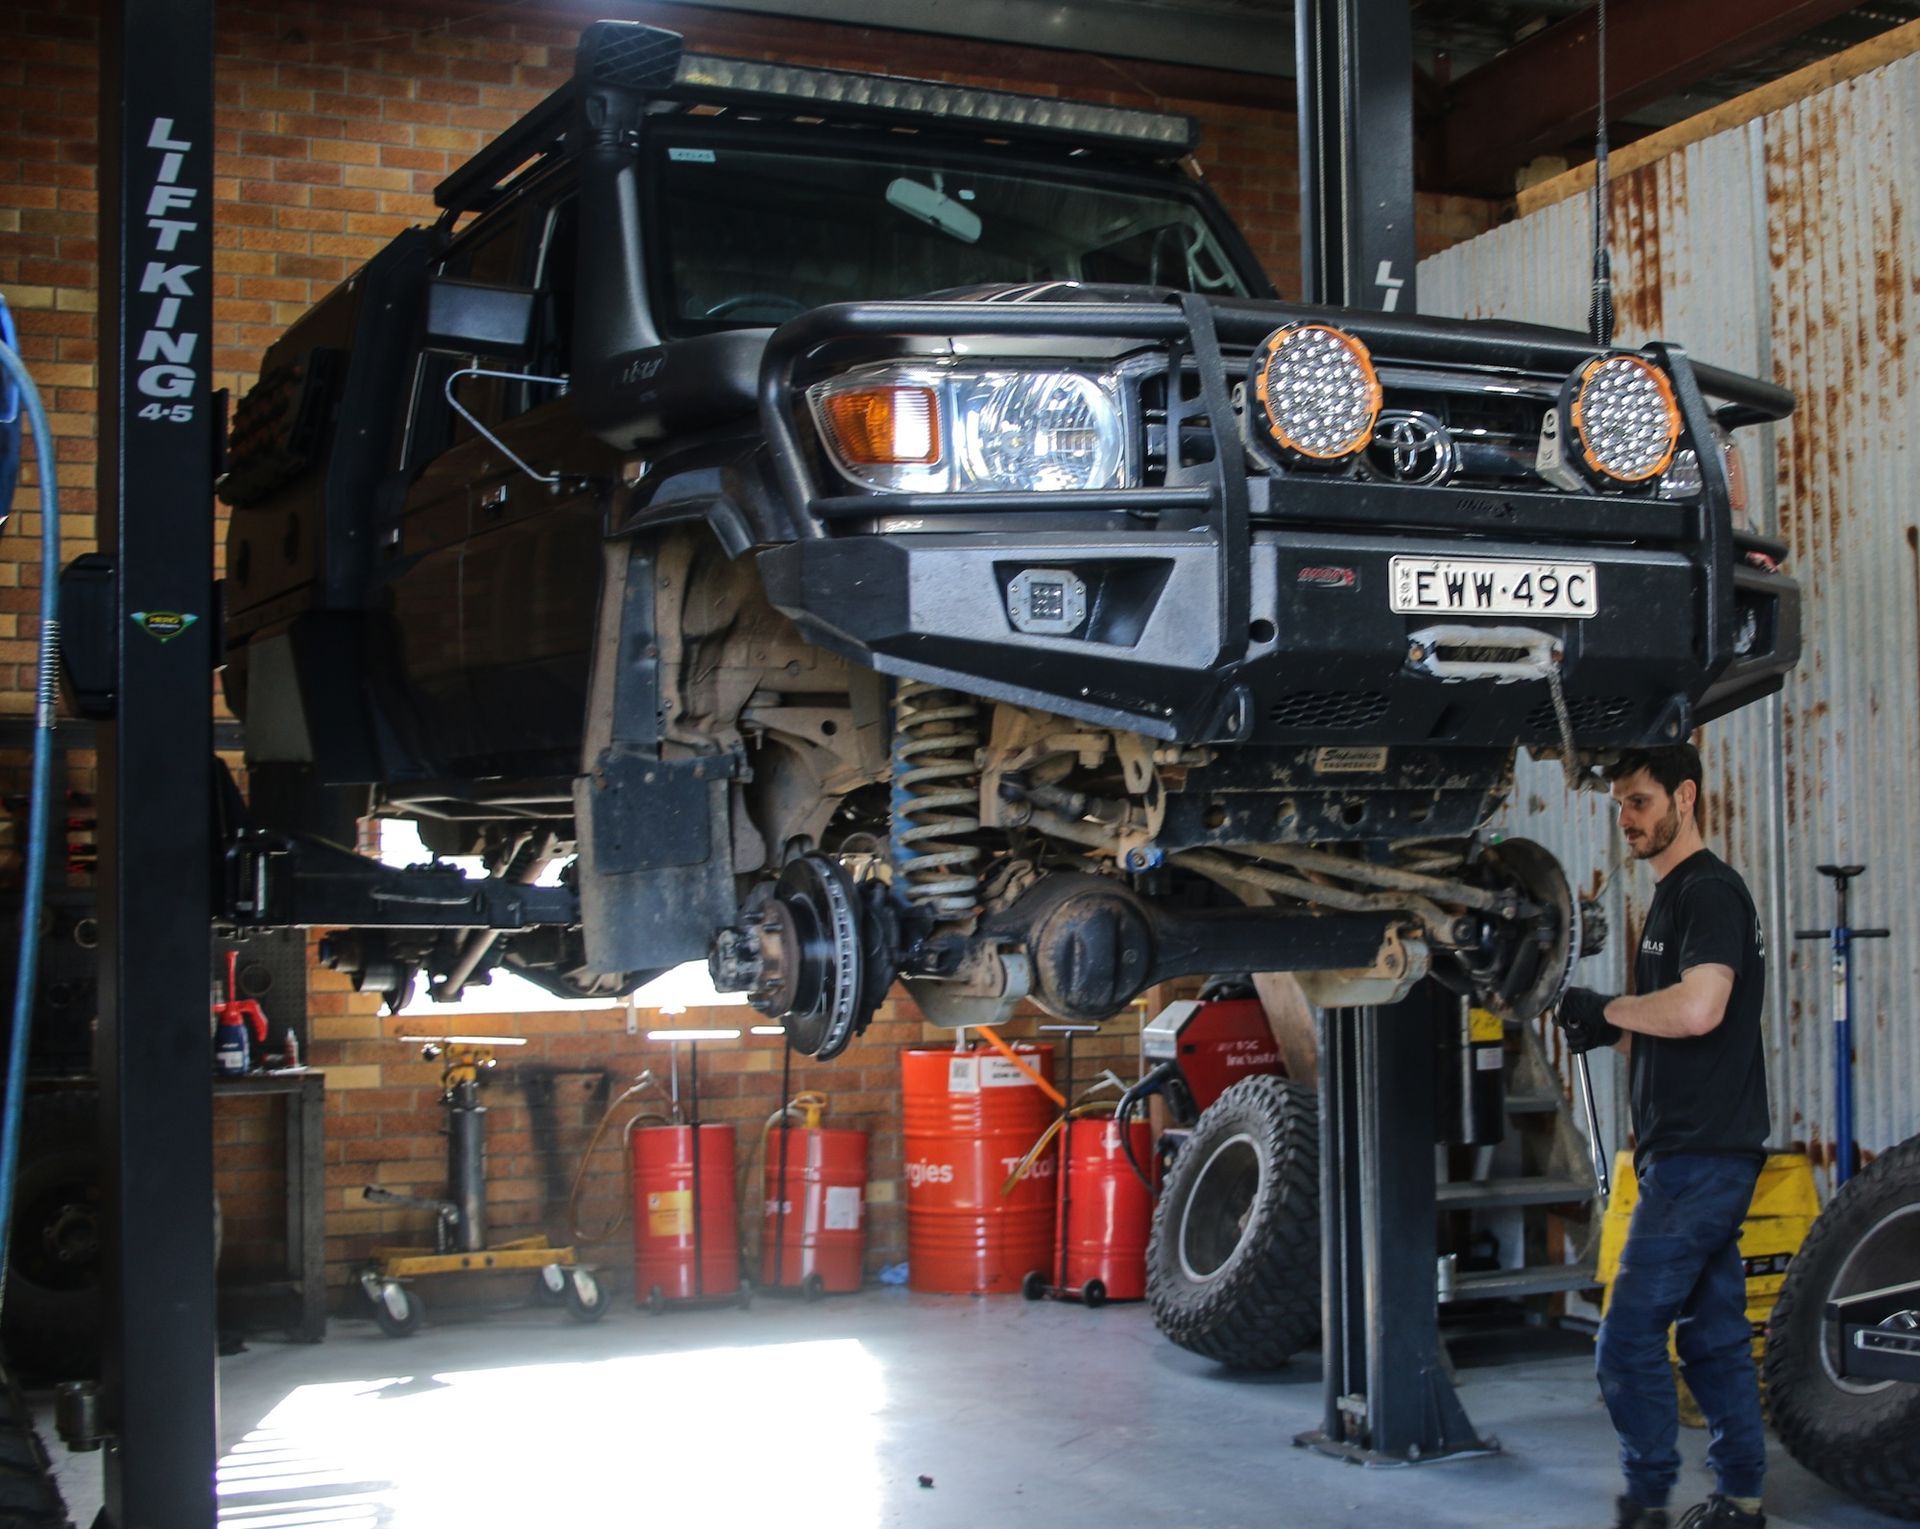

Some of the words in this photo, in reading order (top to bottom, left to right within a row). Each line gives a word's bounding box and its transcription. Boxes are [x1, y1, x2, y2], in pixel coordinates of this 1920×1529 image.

[145, 117, 198, 251] LIFT
[137, 262, 201, 398] KING
[1374, 260, 1405, 312] LI
